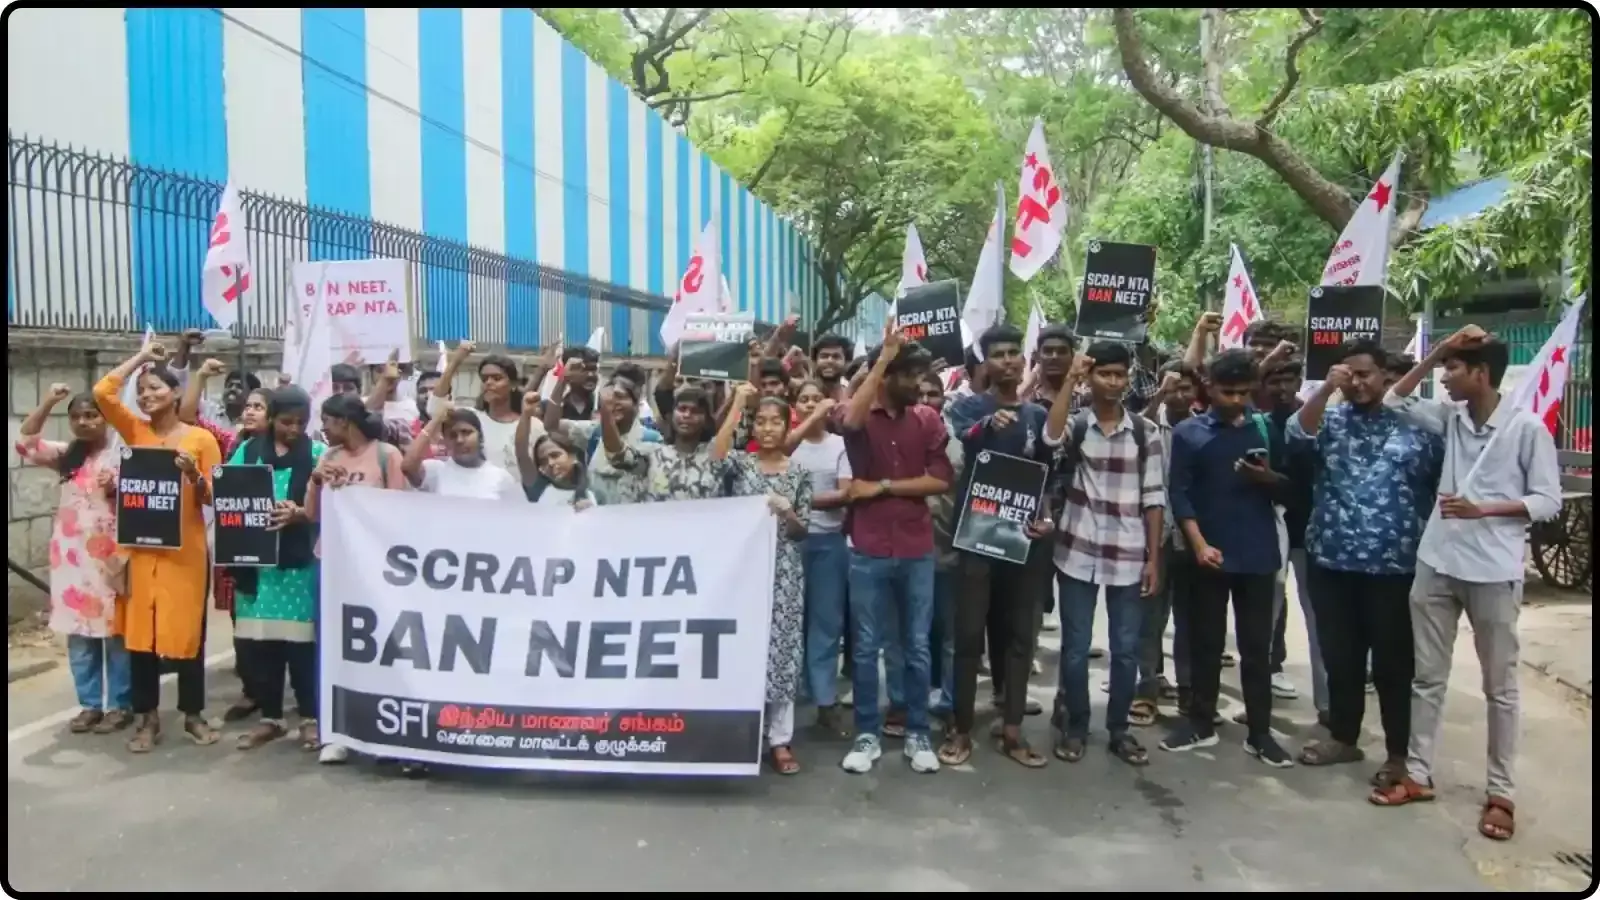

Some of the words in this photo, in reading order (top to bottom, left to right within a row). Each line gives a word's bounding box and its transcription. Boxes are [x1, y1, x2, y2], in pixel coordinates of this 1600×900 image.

[305, 282, 339, 296] BN
[1087, 272, 1125, 288] SCRAP
[1127, 276, 1150, 292] NTA
[1088, 287, 1112, 303] BAN
[1114, 290, 1146, 306] NEET
[303, 302, 356, 317] SRAP
[899, 310, 933, 325] SCRAP
[936, 306, 957, 321] NTA
[927, 321, 955, 337] NEET
[1310, 317, 1352, 331] SCRAP
[1355, 317, 1380, 331] NTA
[1312, 332, 1339, 345] BAN
[120, 478, 156, 495] SCRAP
[158, 480, 180, 496] NTA
[971, 482, 1013, 503] SCRAP
[1013, 492, 1036, 511] NTA
[123, 494, 146, 509] BAN
[147, 495, 177, 511] NEET
[215, 498, 250, 512] SCRAP
[251, 498, 275, 512] NTA
[971, 498, 997, 516] BAN
[998, 505, 1032, 525] NEET
[219, 513, 243, 527] BAN
[382, 544, 576, 597] SCRAP
[593, 555, 698, 598] NTA
[341, 603, 497, 675] BAN
[524, 618, 738, 680] NEET
[376, 697, 429, 739] SFI
[437, 704, 515, 729] இந்திய
[521, 711, 610, 734] மாணவர்
[619, 712, 685, 732] சங்கம்
[436, 729, 516, 749] சென்னை
[519, 733, 590, 752] மாவட்டக்
[594, 735, 668, 757] குழுக்கள்
